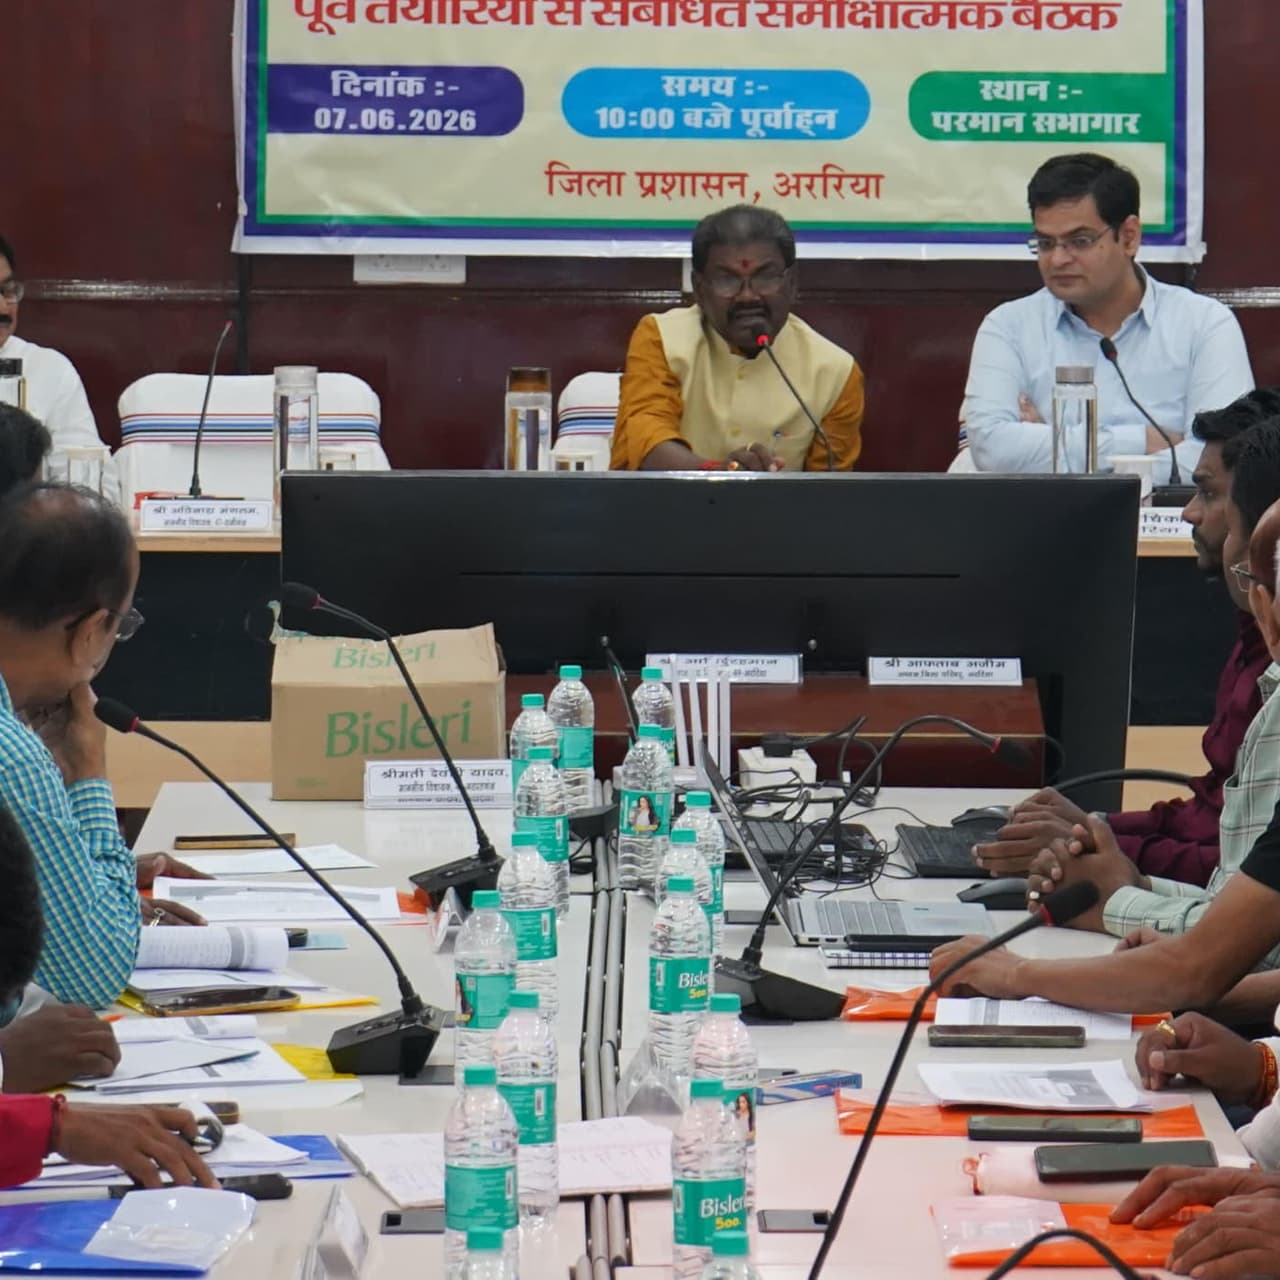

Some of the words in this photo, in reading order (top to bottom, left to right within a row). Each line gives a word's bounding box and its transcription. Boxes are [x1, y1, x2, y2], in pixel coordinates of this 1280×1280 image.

[331, 71, 426, 98] दिनांक
[662, 75, 736, 98] समय
[979, 80, 1050, 104] स्थान
[314, 107, 477, 132] 07.06.2026
[596, 106, 674, 130] 10:00
[683, 102, 732, 130] बजे
[931, 111, 1025, 134] परमान
[1032, 112, 1141, 135] सभागार
[545, 161, 624, 195] जिला
[636, 172, 761, 203] प्रशासन,
[776, 164, 882, 196] अररिया
[884, 657, 901, 668] श्री
[324, 700, 472, 758] Bisleri
[381, 766, 425, 780] श्रीमती
[677, 971, 708, 990] Bisle
[700, 1194, 746, 1218] Bisler
